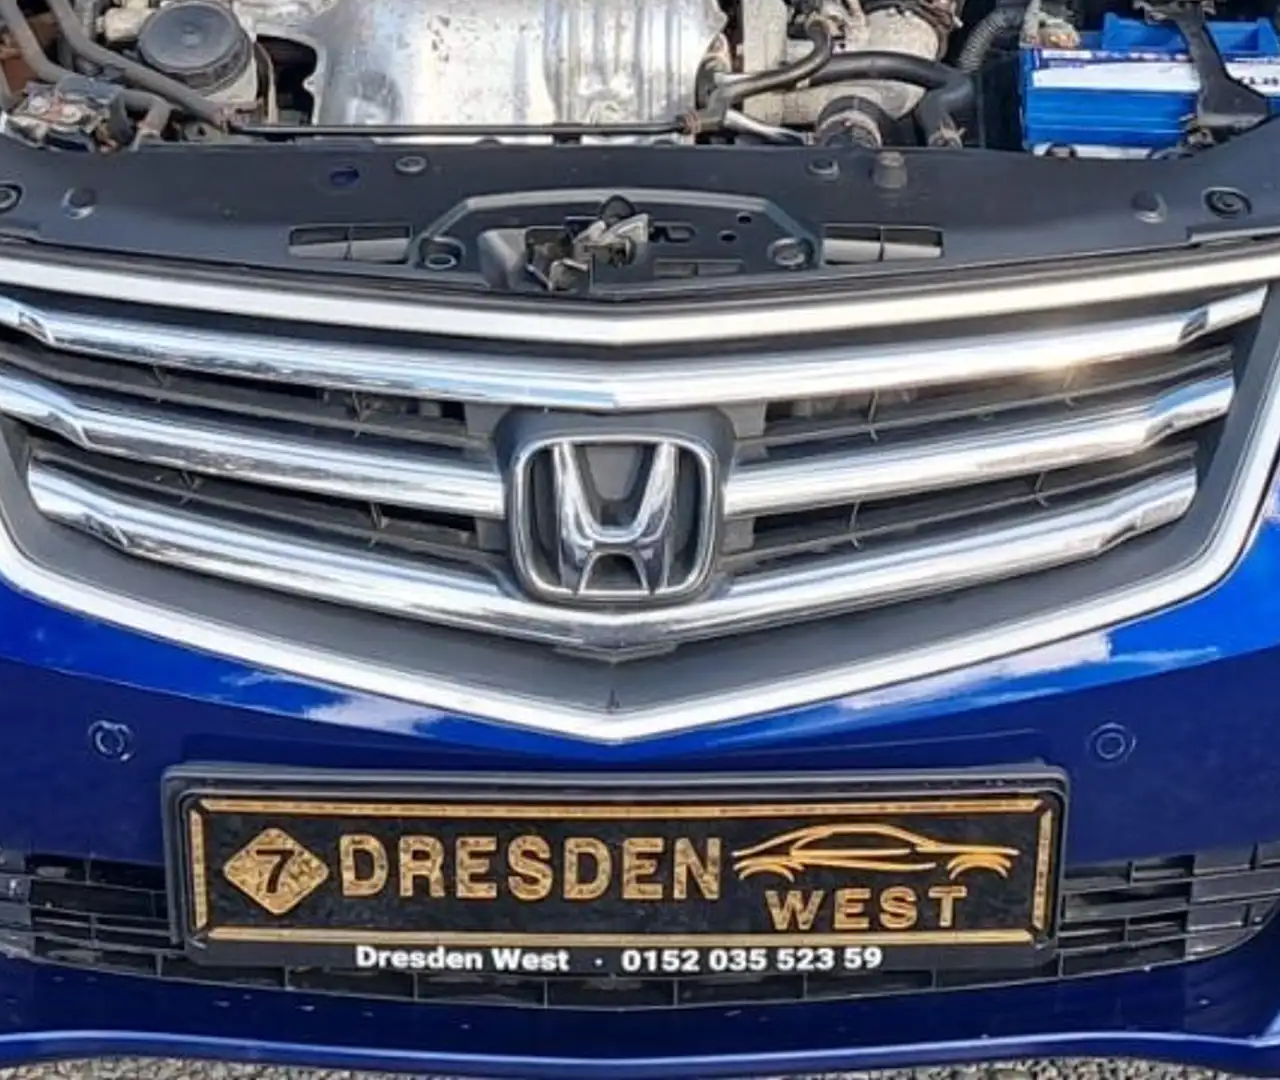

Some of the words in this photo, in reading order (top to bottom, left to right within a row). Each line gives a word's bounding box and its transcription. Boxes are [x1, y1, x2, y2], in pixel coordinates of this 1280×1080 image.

[255, 848, 295, 894] 7
[339, 833, 721, 901] DRESDEN
[764, 885, 969, 931] WEST
[355, 945, 483, 969] Dresden
[490, 947, 570, 971] West
[621, 948, 700, 971] 0152
[708, 948, 768, 971] 035
[776, 946, 836, 970] 523
[843, 946, 883, 969] 59
